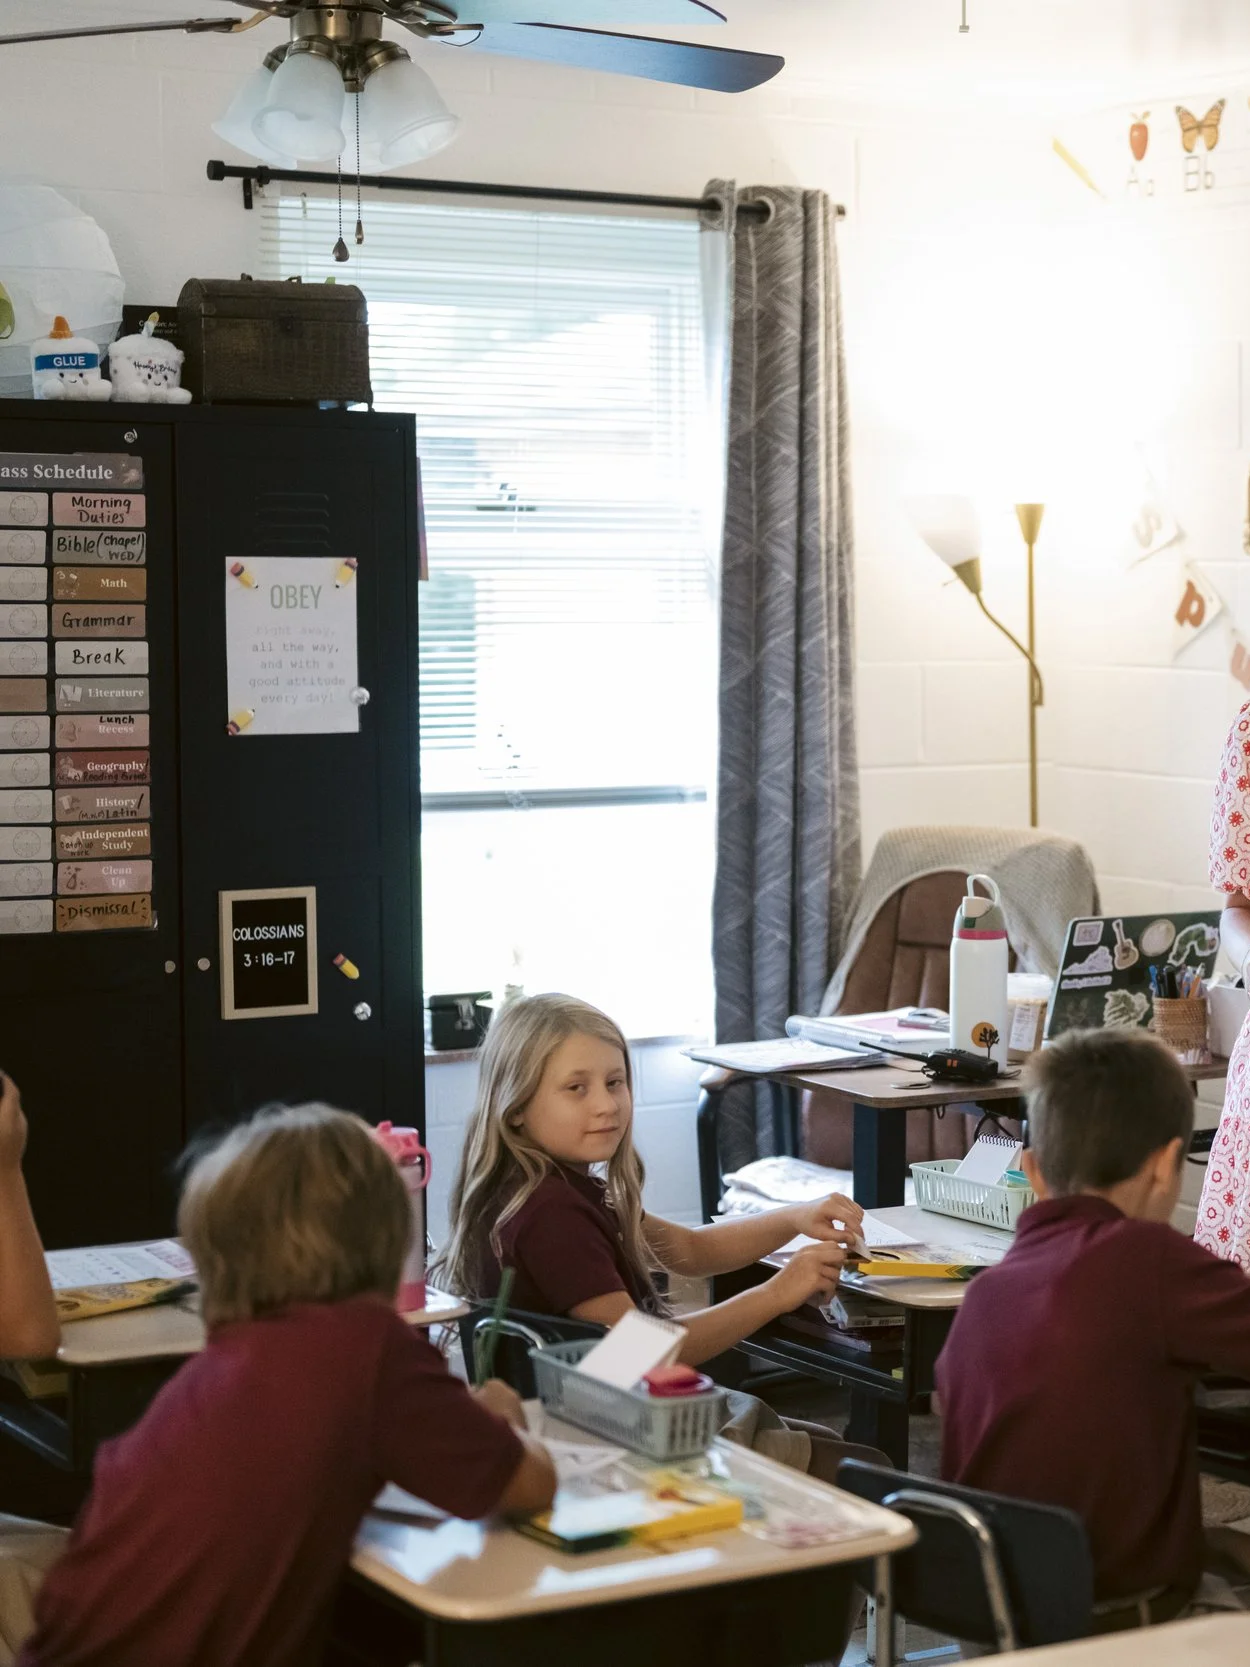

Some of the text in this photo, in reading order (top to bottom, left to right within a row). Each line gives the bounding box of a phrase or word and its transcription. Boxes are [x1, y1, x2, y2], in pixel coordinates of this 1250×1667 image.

[53, 356, 86, 367] GLUE
[33, 464, 113, 480] Schedule
[71, 496, 132, 514] Morning
[77, 509, 125, 524] Duties
[57, 536, 95, 553] Bible
[100, 578, 127, 588] Math
[270, 584, 322, 609] OBEY
[62, 612, 136, 629] Grammar
[252, 642, 273, 653] all
[282, 642, 304, 653] the
[260, 659, 334, 669] and with a
[248, 676, 346, 688] good attitude
[88, 688, 145, 697] Literature
[260, 695, 298, 705] every
[99, 715, 135, 725] Lunch
[98, 724, 134, 734] Recess
[106, 808, 137, 819] Latin
[82, 828, 148, 840] Independent
[102, 840, 133, 851] Study
[101, 866, 132, 875] Clean
[111, 877, 126, 888] Up
[67, 901, 137, 920] Dismissal
[233, 924, 305, 941] COLOSSIANS
